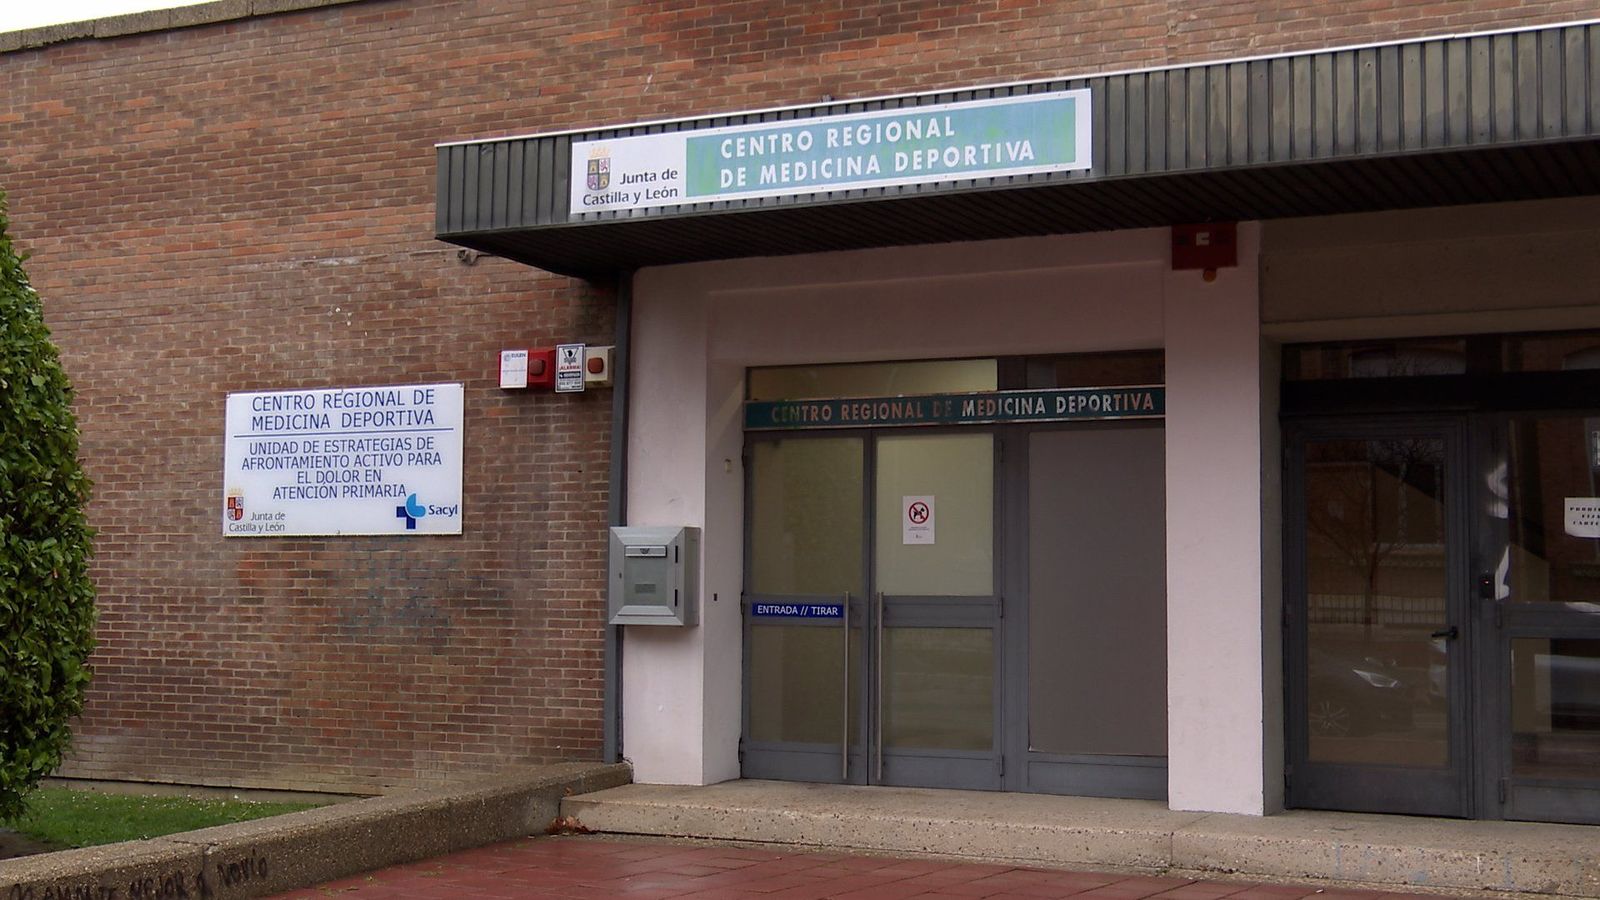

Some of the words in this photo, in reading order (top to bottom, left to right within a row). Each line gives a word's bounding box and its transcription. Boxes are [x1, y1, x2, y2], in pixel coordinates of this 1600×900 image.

[721, 130, 813, 159] CENTRO
[827, 116, 955, 148] REGIONAL
[720, 167, 747, 188] DE
[760, 154, 881, 185] MEDICINA
[895, 140, 1035, 172] DEPORTIVA
[620, 173, 657, 185] Junta
[661, 168, 678, 180] de
[583, 191, 629, 206] Castilla
[633, 191, 641, 205] y
[646, 186, 678, 200] León
[252, 393, 315, 412] CENTRO
[323, 390, 405, 409] REGIONAL
[413, 389, 435, 405] DE
[771, 404, 832, 423] CENTRO
[841, 401, 923, 420] REGIONAL
[933, 400, 952, 417] DE
[962, 397, 1046, 417] MEDICINA
[1056, 393, 1154, 414] DEPORTIVA
[252, 413, 330, 431] MEDICINA
[341, 409, 435, 428] DEPORTIVA
[249, 440, 299, 456] UNIDAD
[303, 440, 319, 454] DE
[324, 437, 412, 453] ESTRATEGIAS
[416, 436, 434, 450] DE
[242, 454, 349, 470] AFRONTAMIENTO
[353, 452, 403, 468] ACTIVO
[407, 451, 442, 466] PARA
[297, 471, 311, 484] EL
[316, 470, 360, 484] DOLOR
[365, 469, 382, 483] EN
[273, 482, 338, 500] ATENCIÓN
[342, 484, 407, 499] PRIMARIA
[250, 511, 275, 521] Junta
[276, 511, 285, 521] de
[428, 504, 458, 516] Sacyl
[229, 523, 256, 532] Castilla
[257, 524, 264, 534] y
[265, 522, 285, 532] León
[757, 605, 798, 614] ENTRADA
[811, 606, 839, 615] TIRAR
